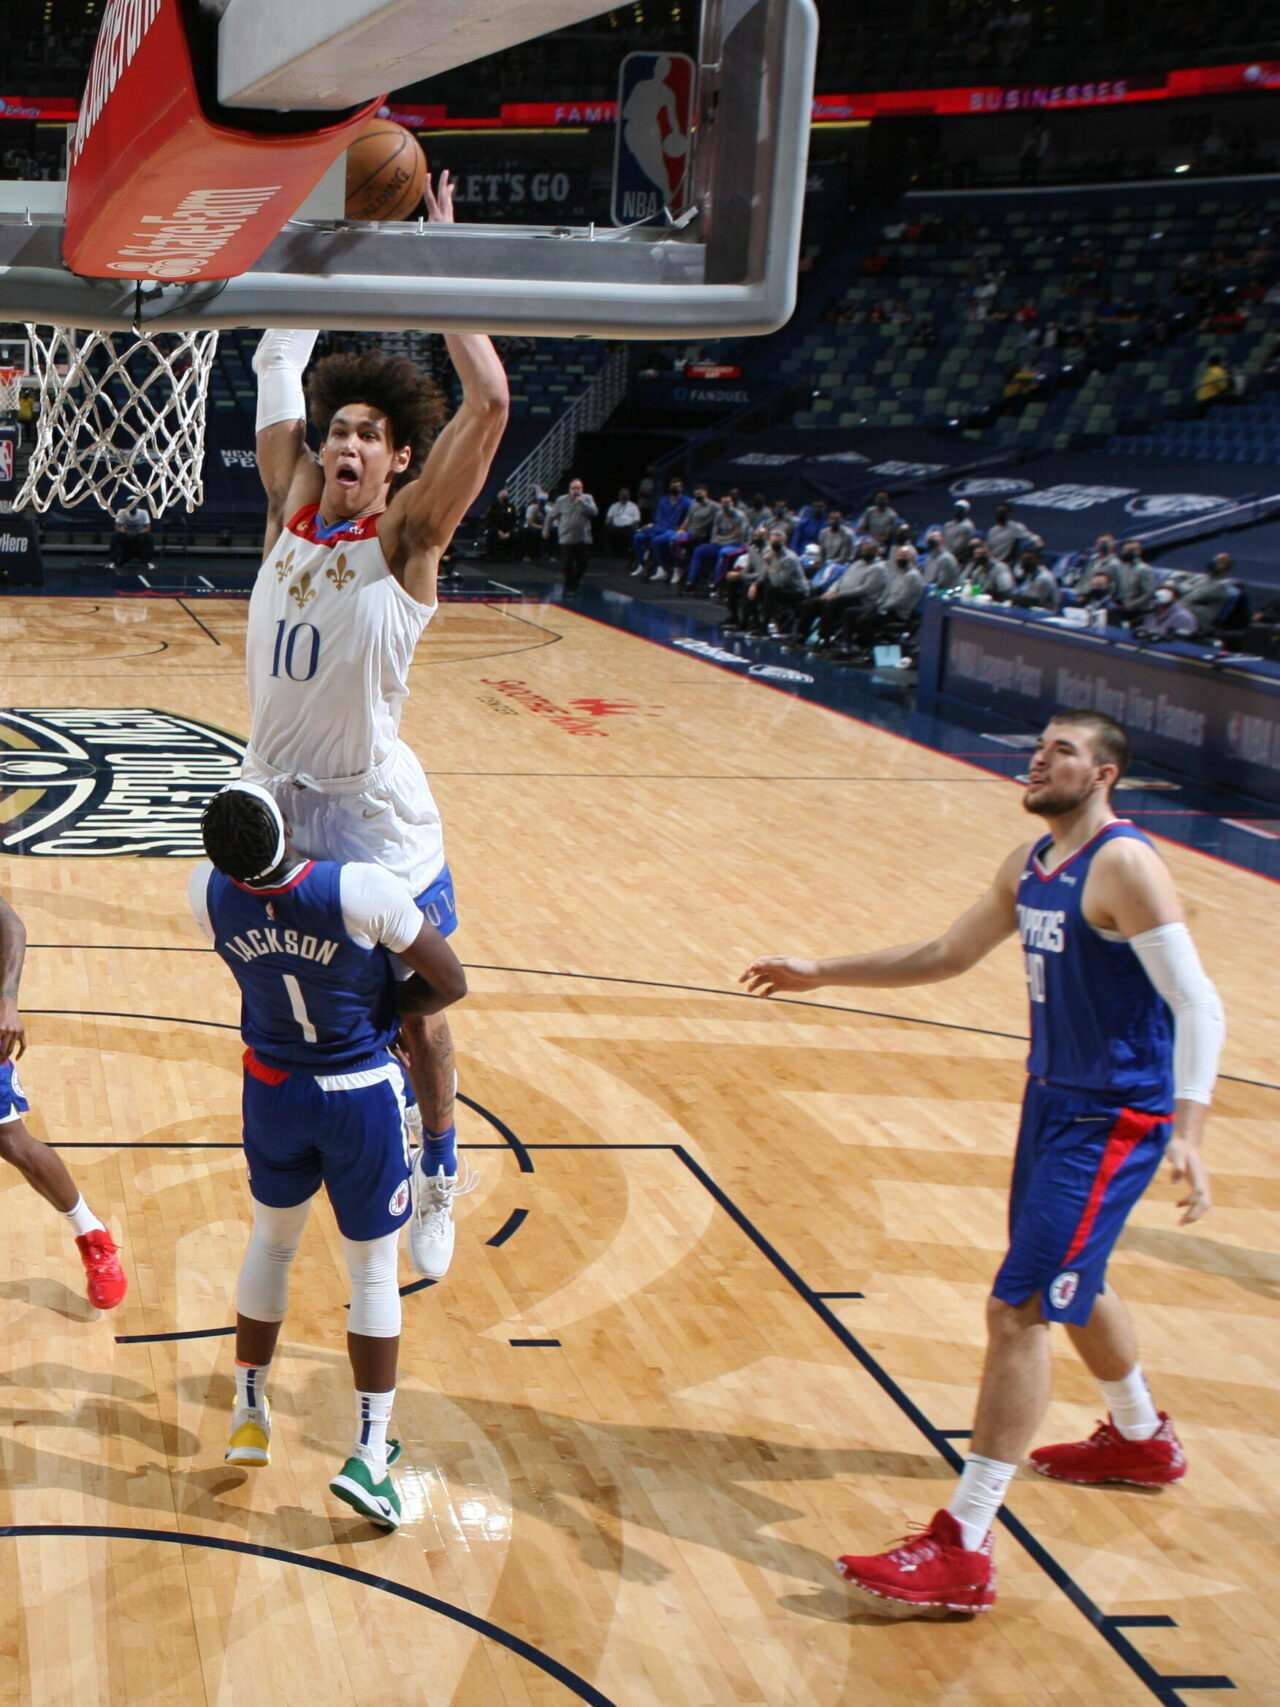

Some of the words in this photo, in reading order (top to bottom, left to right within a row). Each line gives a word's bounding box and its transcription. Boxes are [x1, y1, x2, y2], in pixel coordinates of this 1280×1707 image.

[969, 80, 1128, 111] BUSINESSES
[531, 172, 570, 202] GO
[622, 190, 658, 218] NBA
[269, 619, 321, 682] 10
[225, 928, 340, 966] JACKSON
[282, 974, 318, 1043] 1
